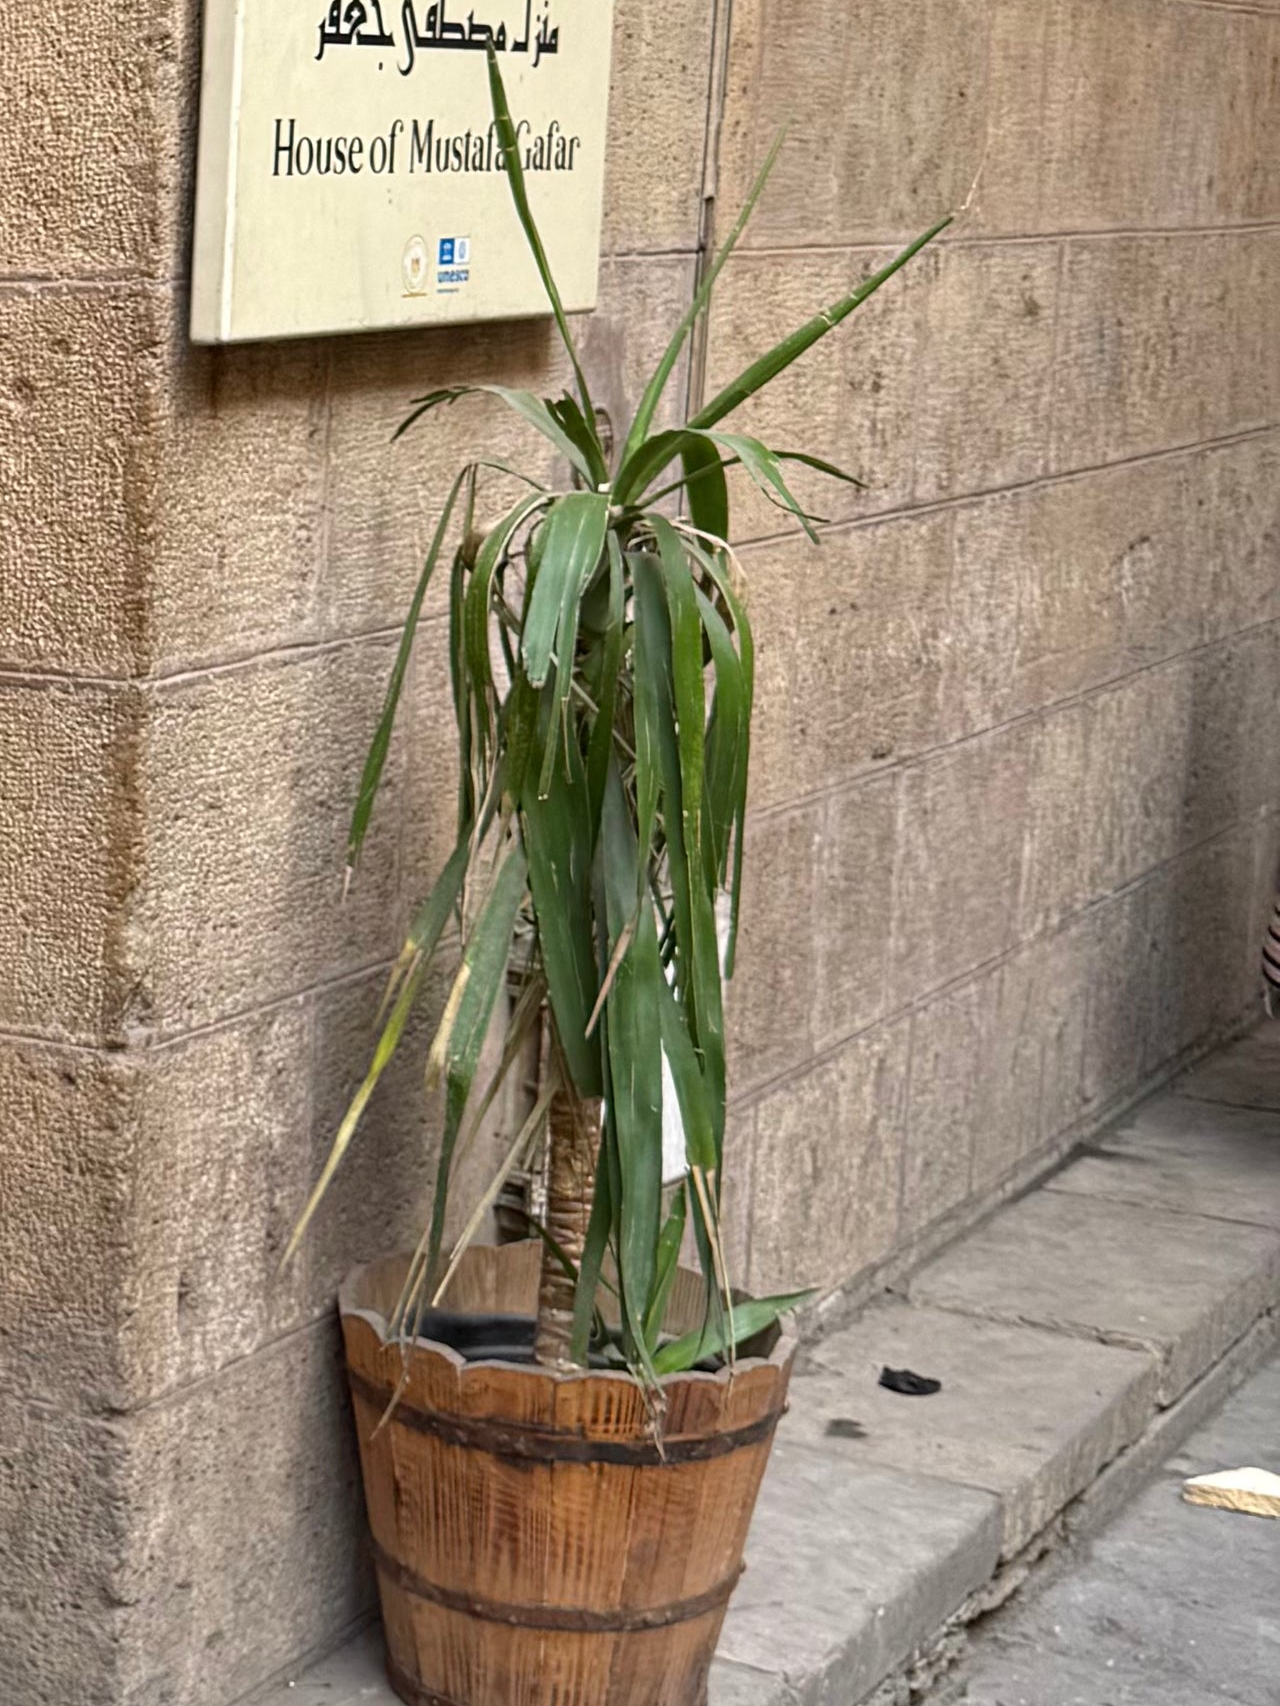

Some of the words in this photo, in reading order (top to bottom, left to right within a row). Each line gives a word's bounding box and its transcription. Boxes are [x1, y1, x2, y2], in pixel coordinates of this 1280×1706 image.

[273, 118, 364, 176] House
[369, 118, 404, 174] of
[514, 118, 581, 171] Gafar
